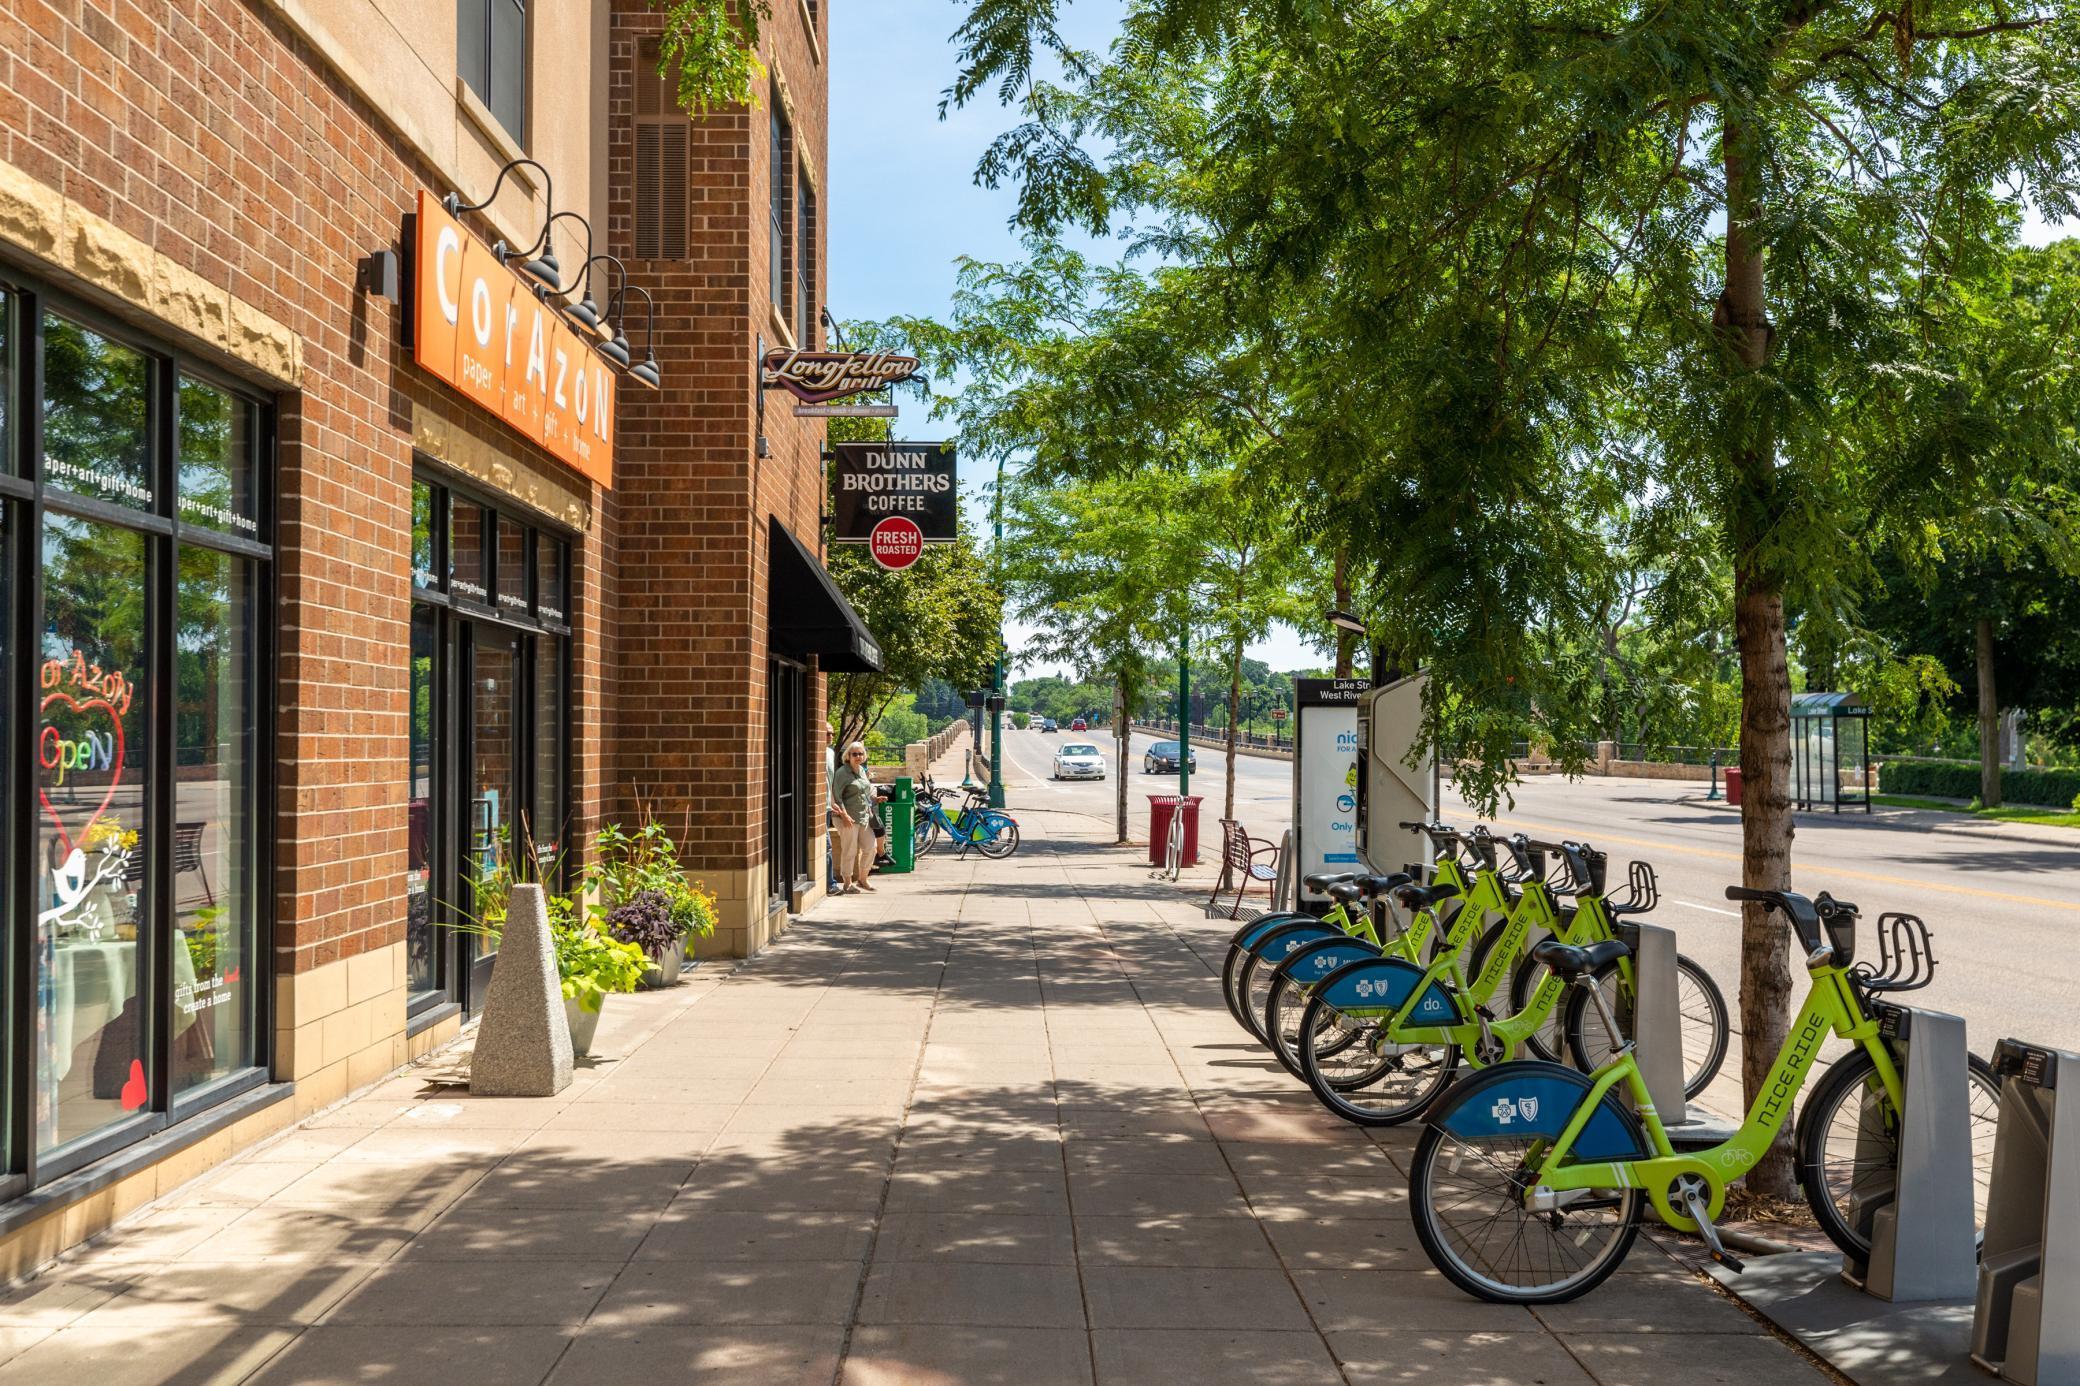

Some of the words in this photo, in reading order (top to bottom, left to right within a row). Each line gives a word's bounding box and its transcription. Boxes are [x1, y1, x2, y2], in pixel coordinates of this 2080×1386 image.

[764, 346, 917, 390] Longfellow
[837, 376, 883, 391] grill
[463, 353, 492, 390] paper
[513, 390, 526, 415] art
[544, 410, 558, 438] gift
[572, 428, 591, 461] home
[866, 452, 927, 469] DUNN
[44, 455, 153, 502] aper+art+gift+home
[843, 473, 950, 493] BROTHERS
[868, 495, 925, 511] COFFEE
[876, 531, 917, 544] FRESH
[876, 545, 917, 555] ROASTED
[1333, 681, 1355, 689] Lake
[1357, 681, 1370, 689] Str
[1320, 691, 1342, 699] West
[1343, 691, 1362, 699] Rive
[1848, 706, 1866, 714] Lake
[1337, 730, 1357, 744] nic
[1331, 822, 1353, 832] Only
[1458, 902, 1480, 937] RIDE
[193, 978, 211, 993] from
[212, 972, 224, 988] the
[183, 998, 206, 1014] create
[206, 998, 212, 1007] a
[213, 990, 232, 1005] home
[1787, 1012, 1825, 1070] RIDE
